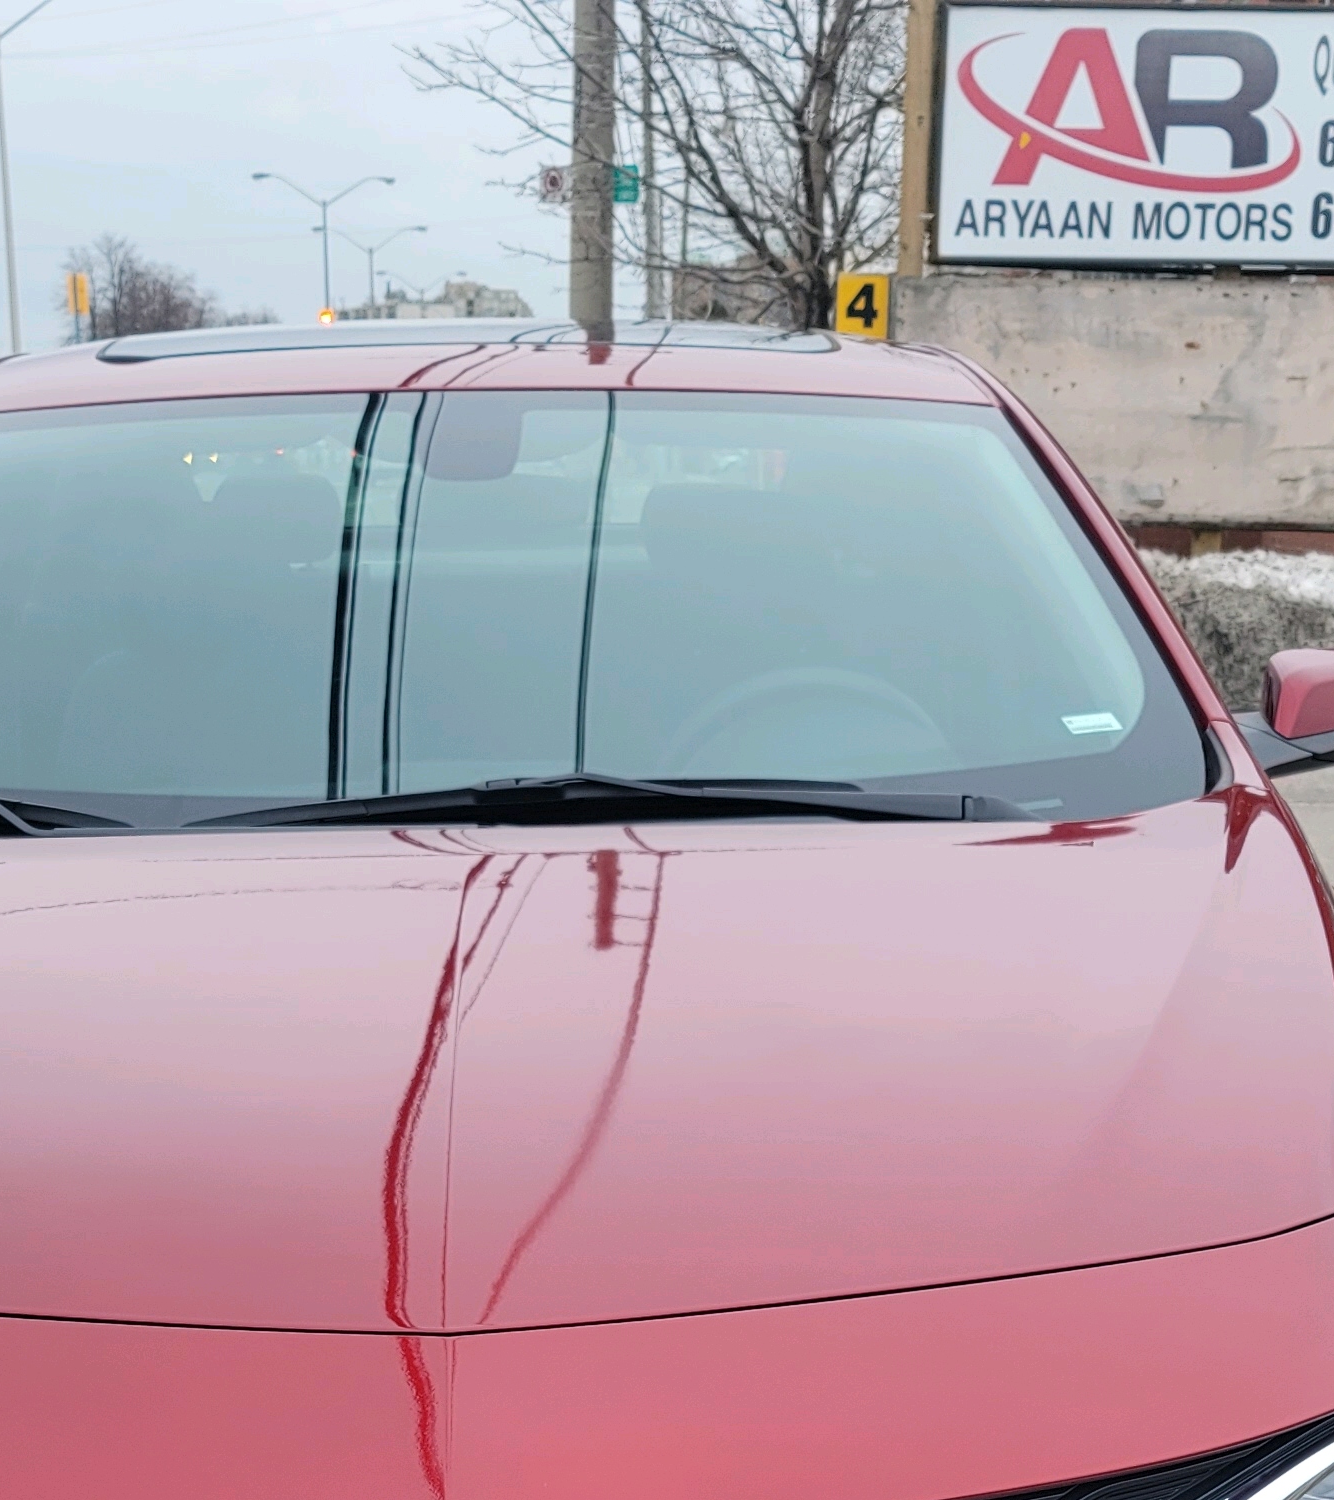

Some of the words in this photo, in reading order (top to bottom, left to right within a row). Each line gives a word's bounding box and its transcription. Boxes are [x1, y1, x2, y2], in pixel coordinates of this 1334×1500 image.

[991, 27, 1279, 186] AR
[954, 199, 1114, 240] ARYAAN
[1131, 200, 1294, 242] MOTORS
[845, 282, 879, 329] 4
